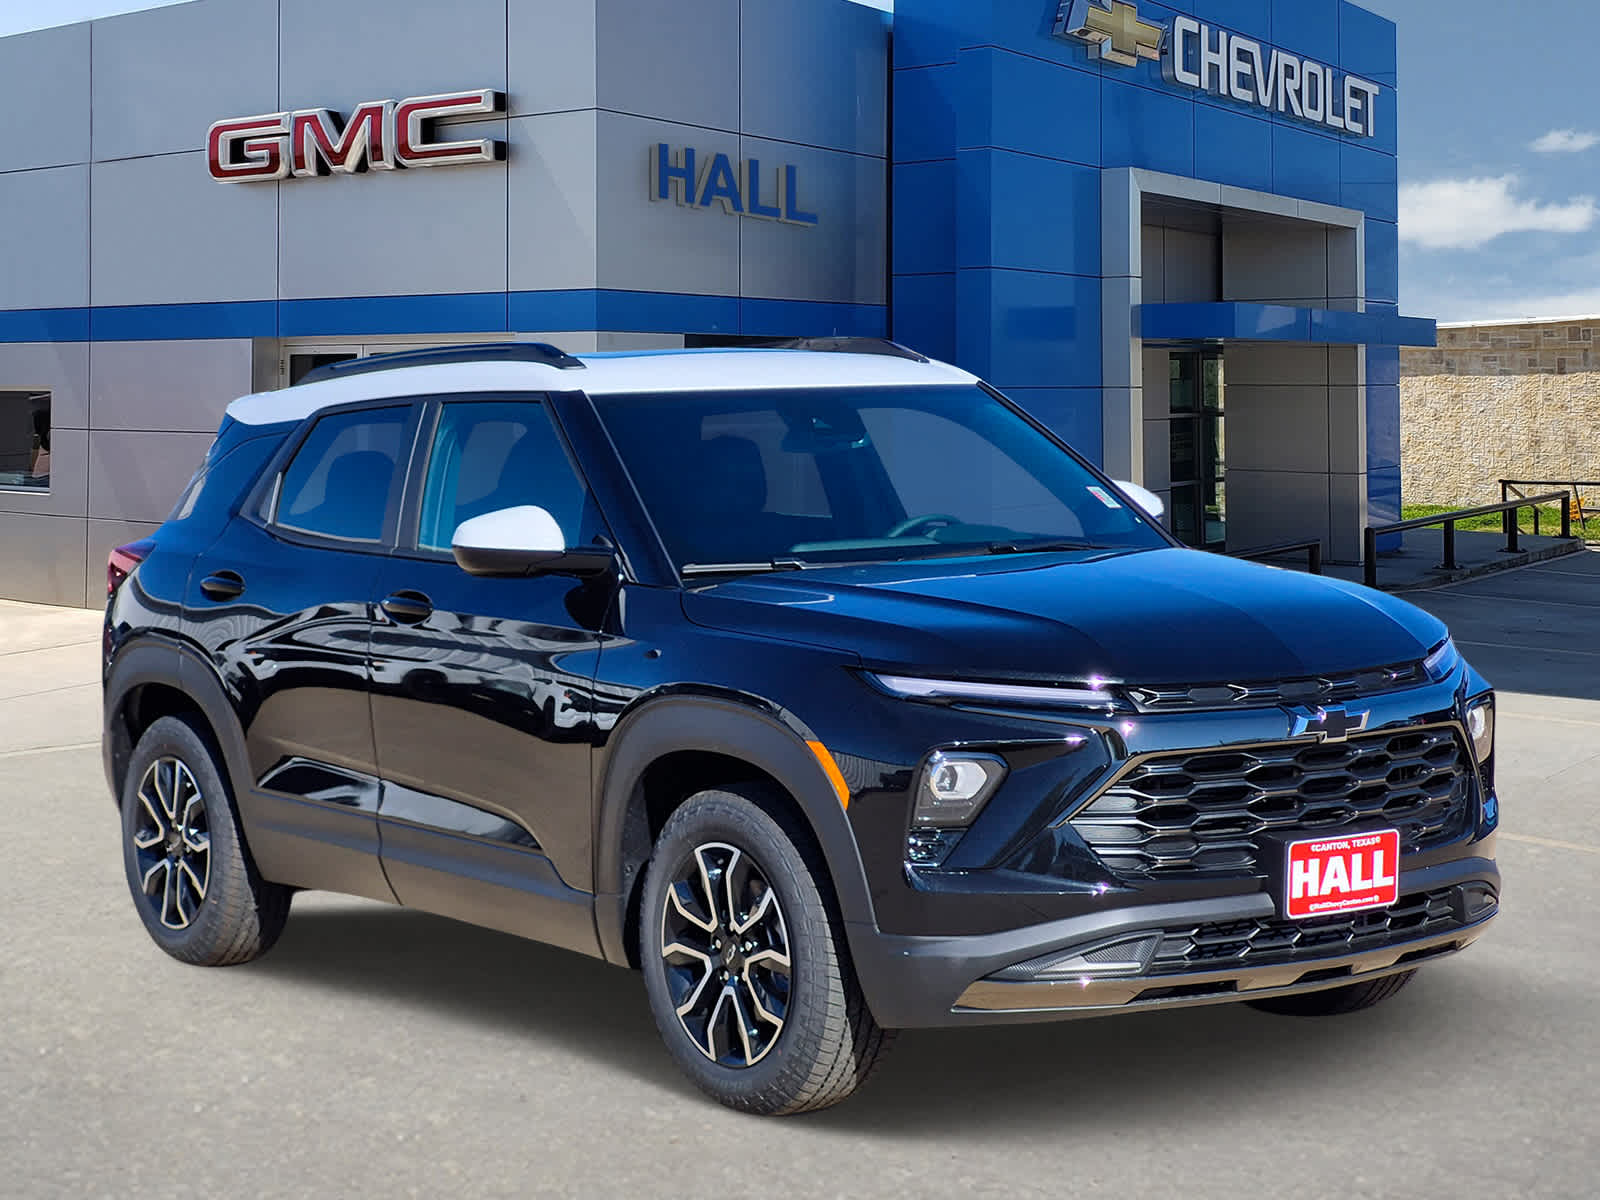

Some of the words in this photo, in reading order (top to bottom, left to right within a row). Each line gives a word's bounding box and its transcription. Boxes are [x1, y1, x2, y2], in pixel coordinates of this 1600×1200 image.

[1174, 15, 1379, 137] CHEVROLET
[206, 88, 507, 184] GMC
[651, 142, 819, 226] HALL
[1291, 850, 1394, 899] HALL
[1352, 837, 1376, 848] TEXAS
